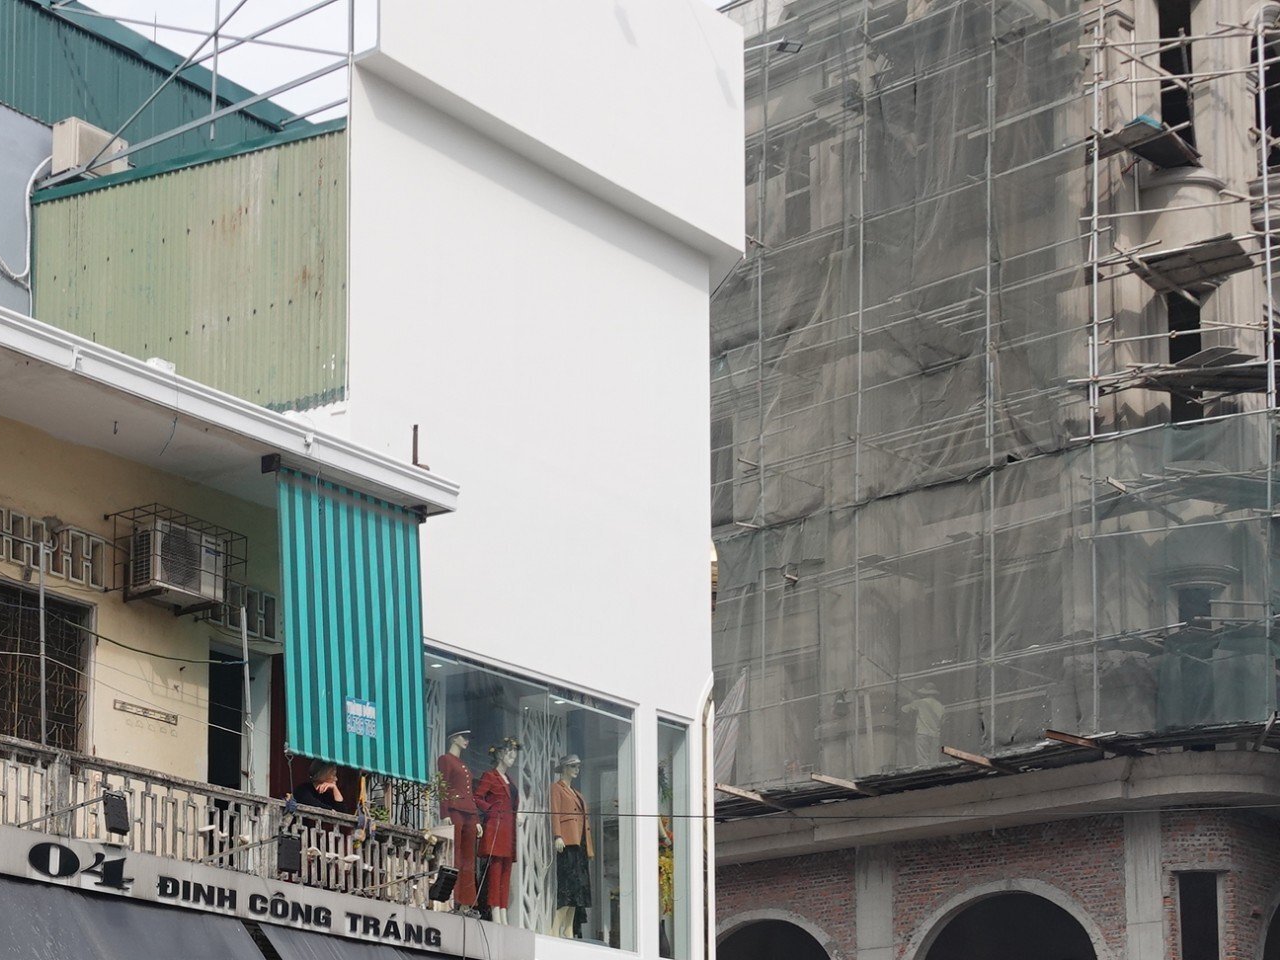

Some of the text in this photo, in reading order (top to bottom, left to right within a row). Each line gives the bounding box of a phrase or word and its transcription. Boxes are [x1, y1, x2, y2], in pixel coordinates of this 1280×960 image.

[27, 841, 442, 948] 04 ĐINH CÔNG TRÁNG
